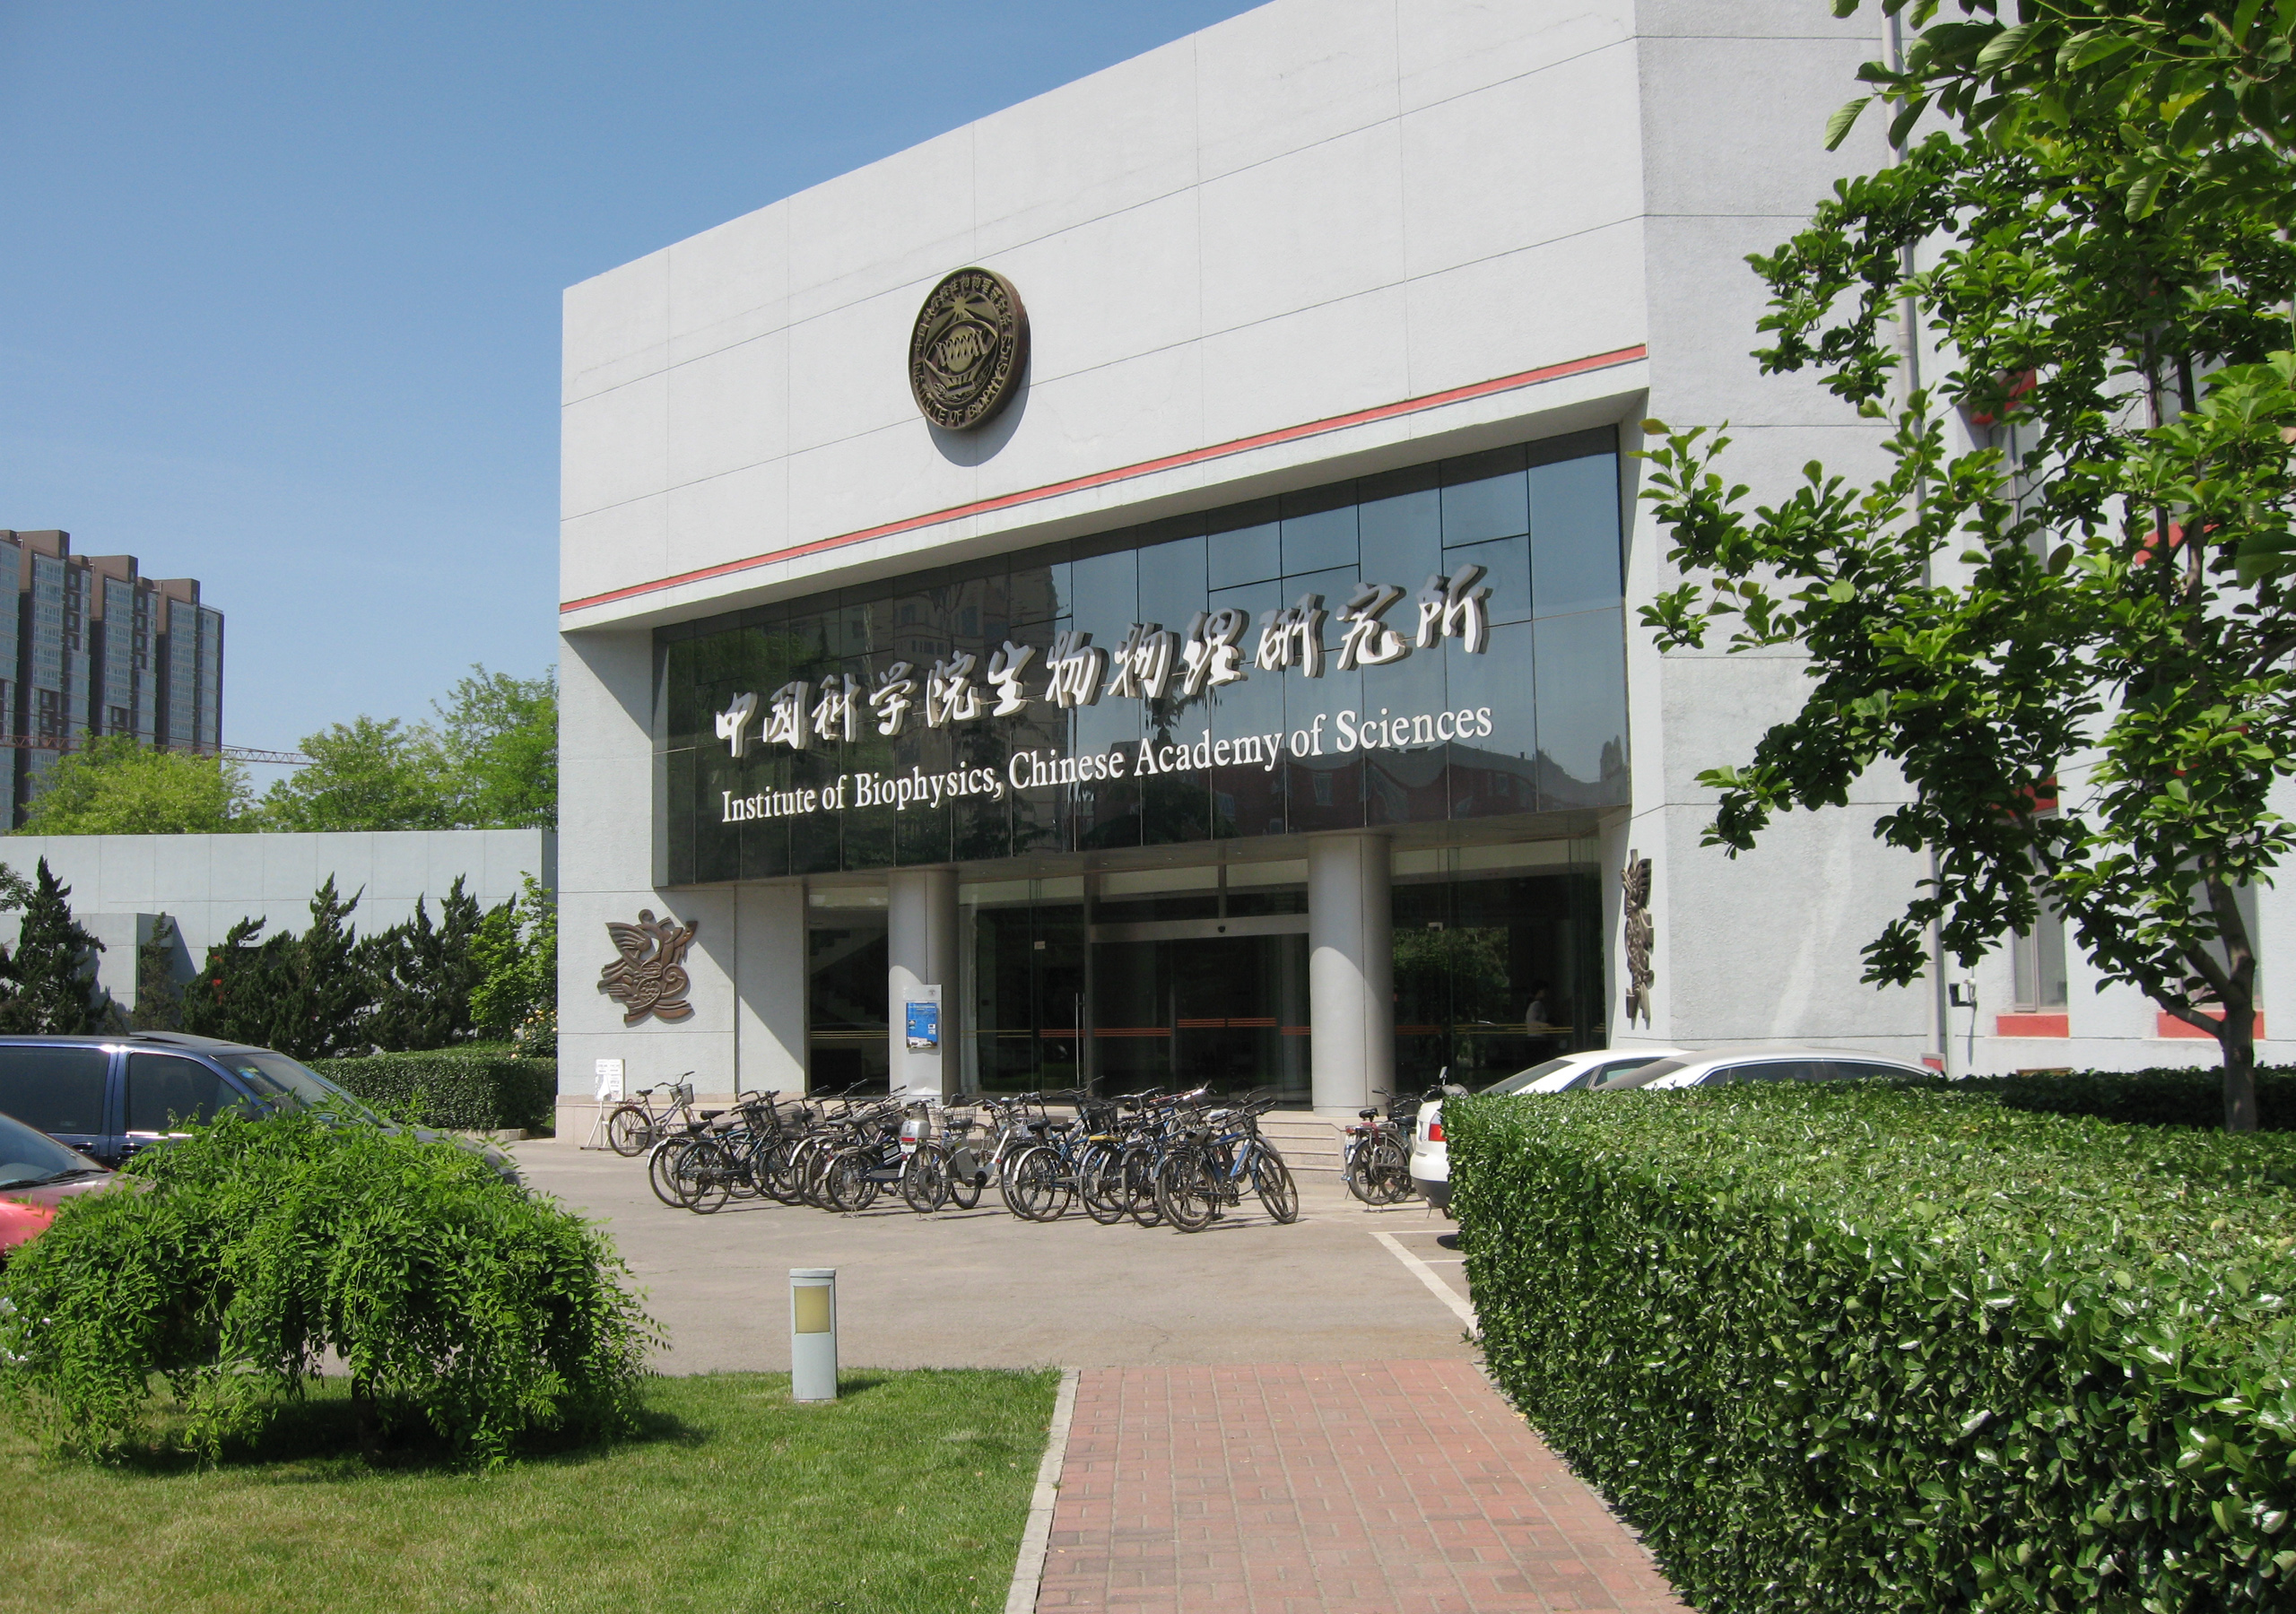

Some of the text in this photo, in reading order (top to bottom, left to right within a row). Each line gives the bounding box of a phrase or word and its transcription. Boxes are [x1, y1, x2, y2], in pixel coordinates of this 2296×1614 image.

[913, 334, 1013, 422] INSTITUTE OF BIOPHYSICS
[722, 707, 1493, 823] Institute of Biophysics, Chinese Academy of Sciences
